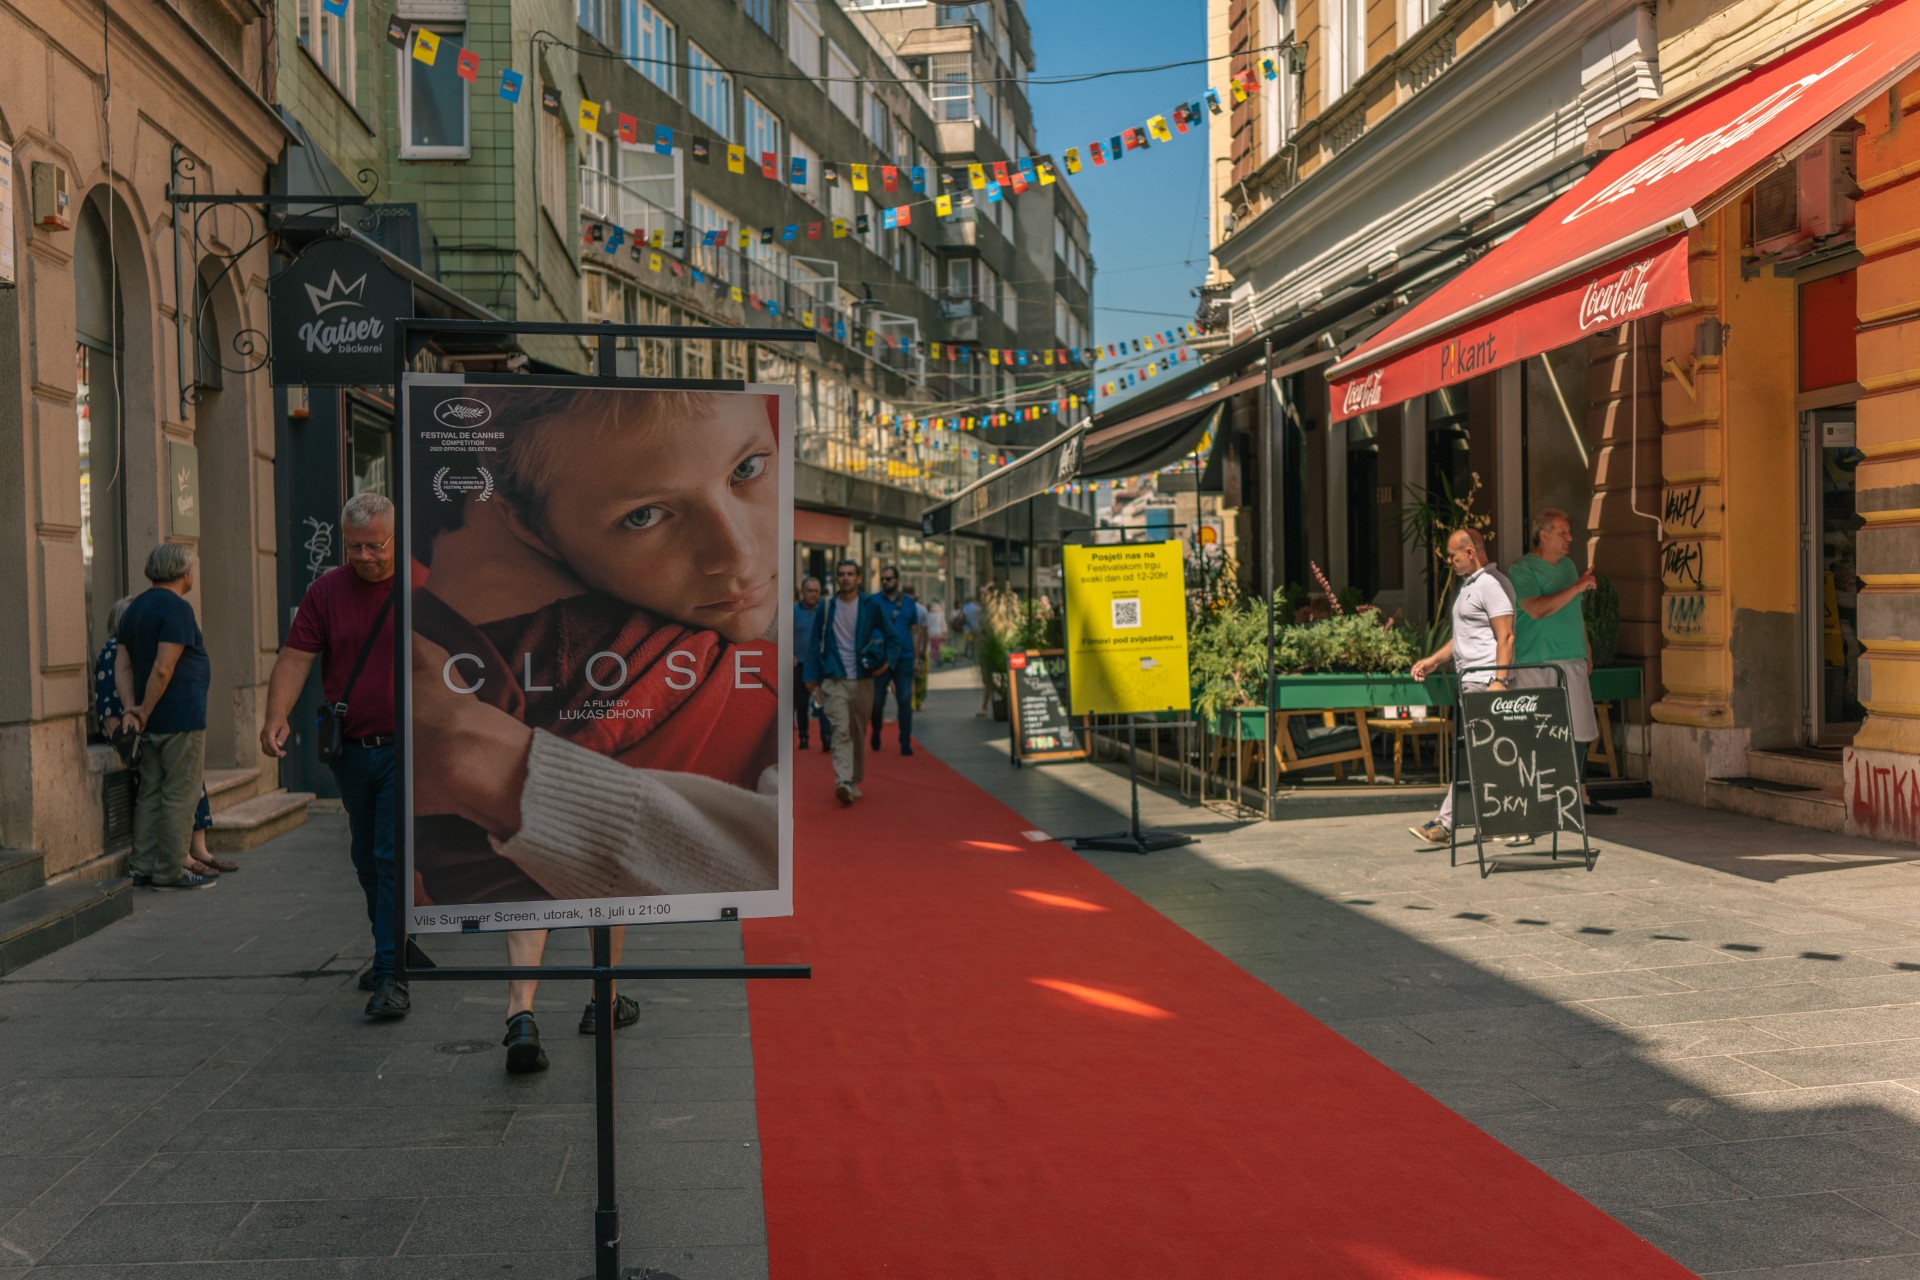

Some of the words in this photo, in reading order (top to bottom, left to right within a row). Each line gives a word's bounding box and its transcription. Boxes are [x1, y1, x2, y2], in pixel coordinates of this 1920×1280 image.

[1580, 258, 1655, 330] Coca-Cola
[298, 317, 384, 354] Kaiser
[338, 343, 382, 353] bäckerei
[1343, 369, 1384, 415] Coca-Cola
[1087, 563, 1142, 572] Festivalskom
[1144, 562, 1161, 571] trgu
[1092, 553, 1123, 563] Posjeti
[1081, 575, 1103, 583] svaki
[1104, 573, 1121, 582] dan
[1123, 573, 1134, 581] od
[1137, 571, 1168, 580] 12-20h!
[1082, 637, 1111, 646] Filmovi
[1113, 637, 1128, 645] pod
[1130, 634, 1174, 644] zvijezdama
[443, 651, 763, 694] CLOSE
[560, 709, 604, 719] LUKAS
[606, 709, 654, 719] DHONT
[1491, 695, 1539, 715] Coca-Cola
[1482, 783, 1502, 817] 5
[414, 916, 436, 926] Vils
[494, 911, 540, 923] Screen,
[543, 909, 583, 920] utorak,
[588, 907, 605, 918] 18.
[608, 906, 625, 919] juli
[628, 907, 635, 916] u
[638, 904, 671, 915] 21:00
